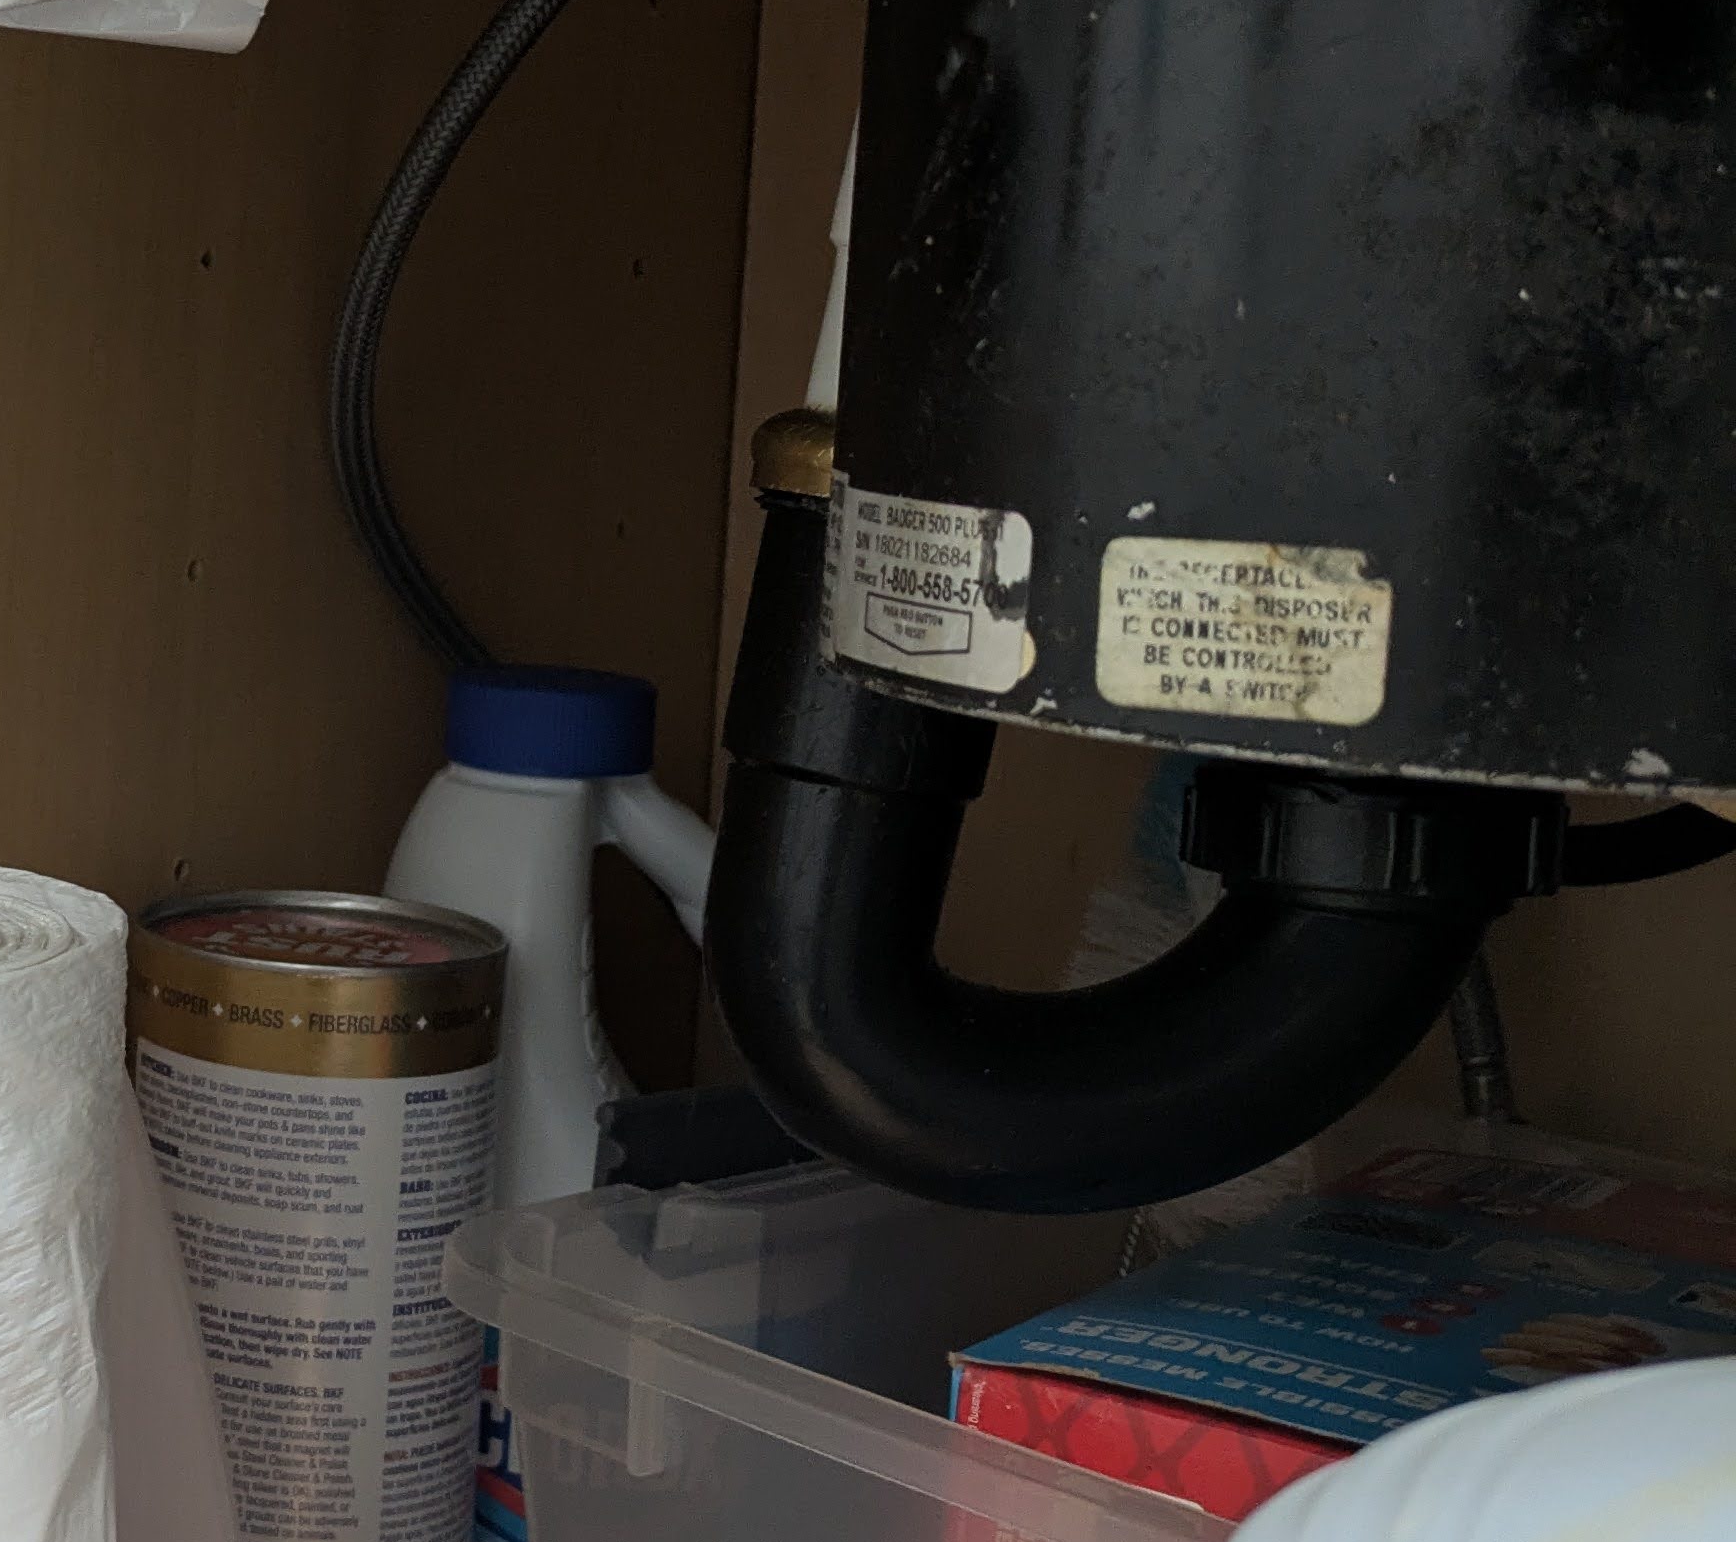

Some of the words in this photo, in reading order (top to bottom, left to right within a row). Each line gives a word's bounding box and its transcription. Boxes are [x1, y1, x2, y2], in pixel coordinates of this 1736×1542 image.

[886, 506, 927, 532] BADGER
[928, 513, 950, 535] 500
[1144, 645, 1171, 665] BE
[1160, 674, 1187, 695] BY
[160, 986, 209, 1015] COPPER
[229, 1003, 284, 1030] BRASS
[308, 1012, 412, 1035] FIBERGLASS
[335, 1108, 354, 1121] and
[313, 1187, 332, 1198] and
[335, 1347, 363, 1360] NOTE
[1057, 1319, 1450, 1411] STRONGER
[214, 1372, 260, 1391] DELICATE
